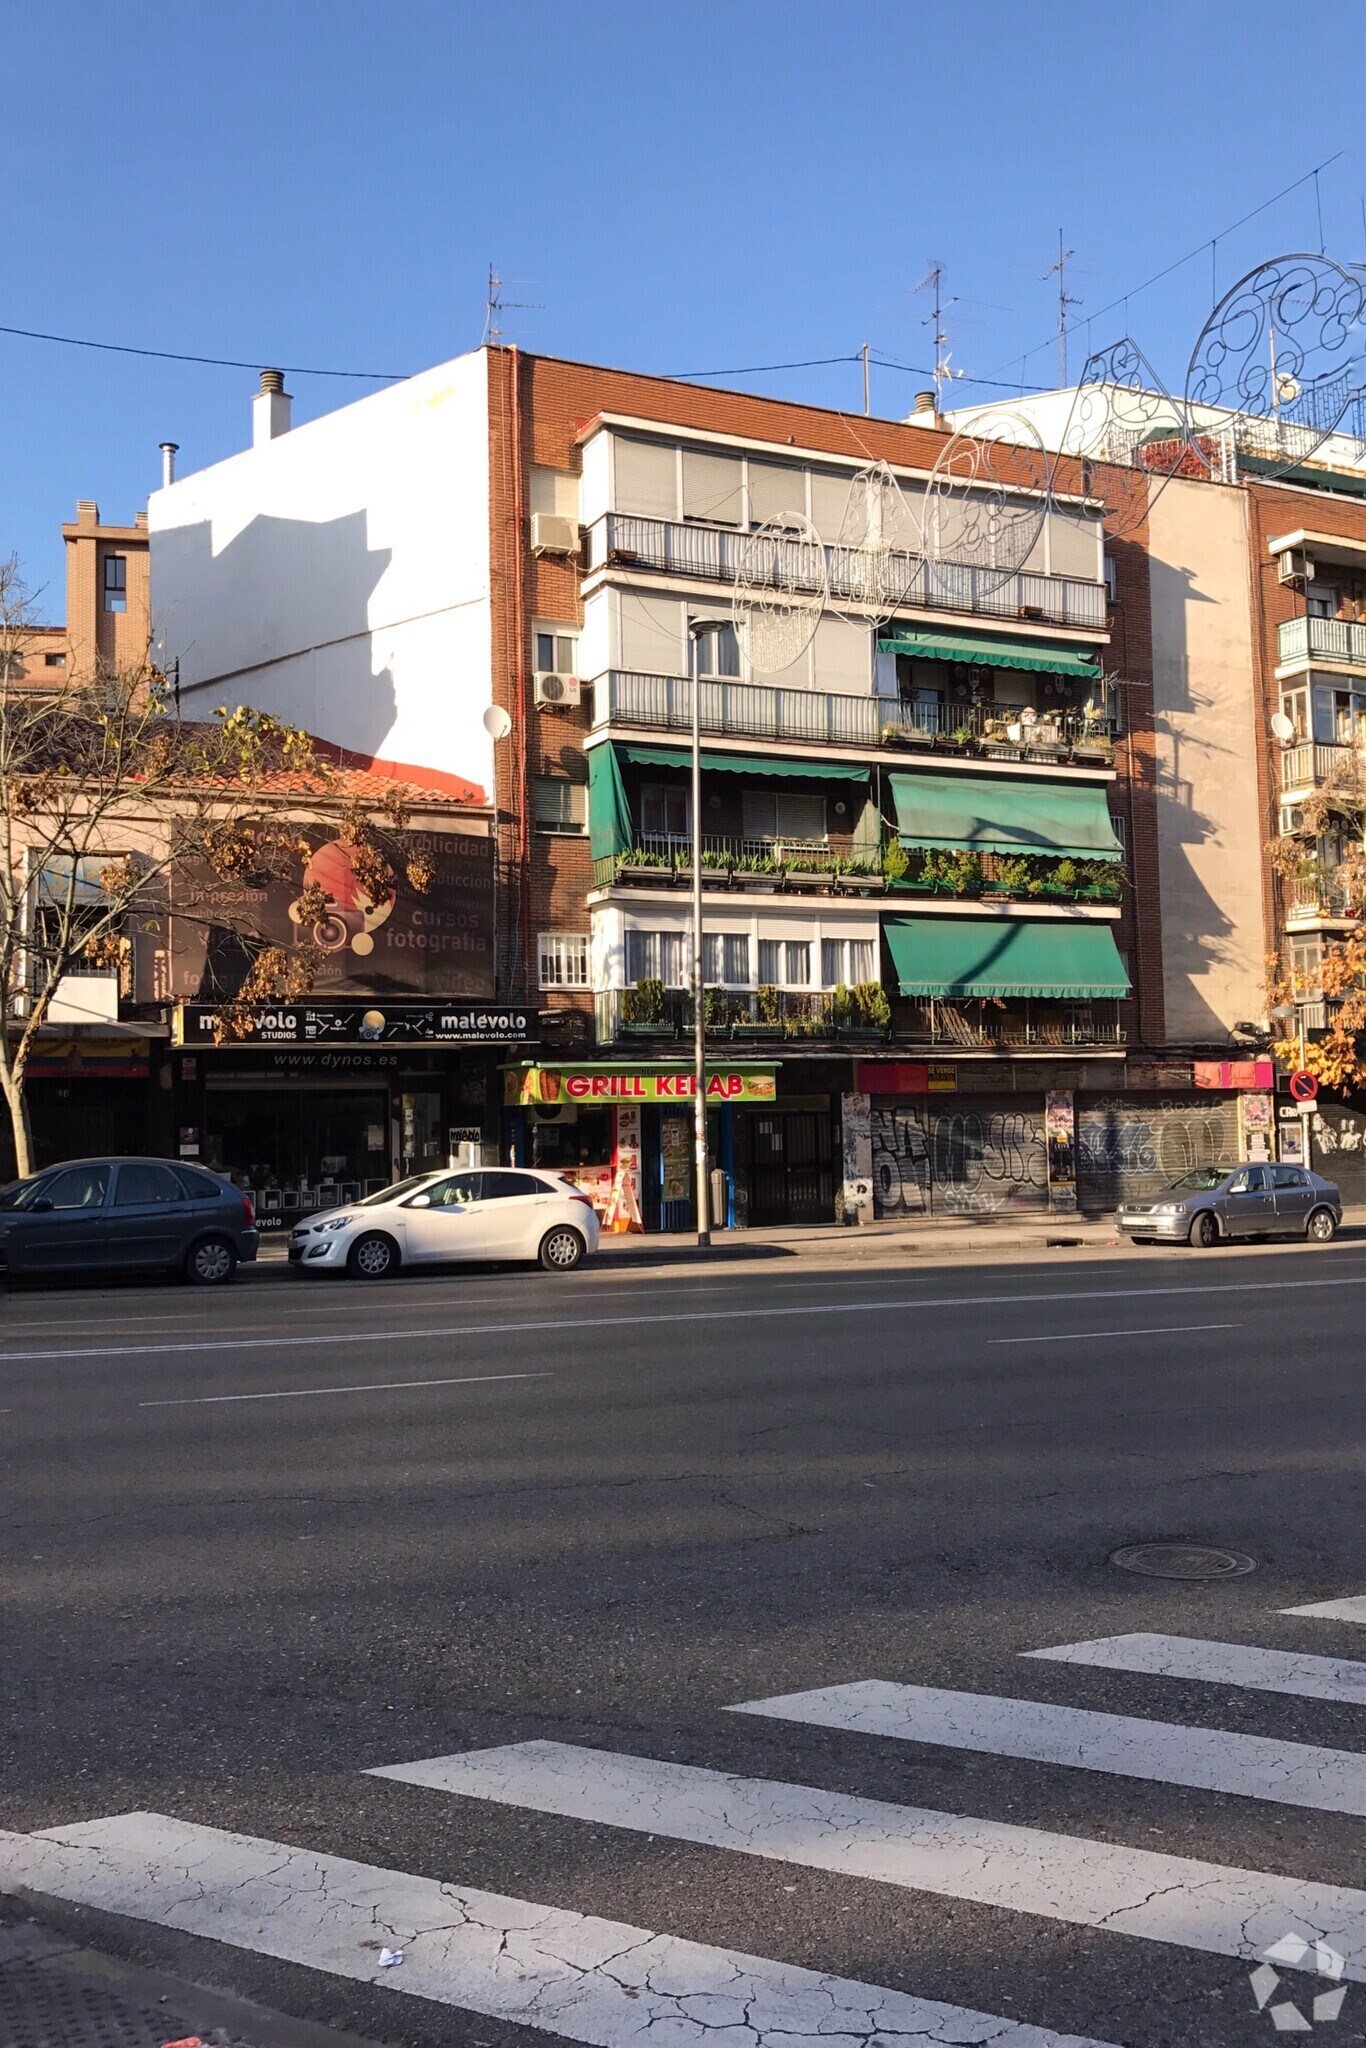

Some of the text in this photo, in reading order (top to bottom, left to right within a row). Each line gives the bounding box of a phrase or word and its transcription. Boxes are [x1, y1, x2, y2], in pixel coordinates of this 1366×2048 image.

[431, 870, 491, 888] ducción
[412, 910, 479, 929] cursos
[386, 928, 487, 953] fotografía
[199, 1010, 297, 1030] mvolo
[261, 1031, 297, 1040] STUDIOS
[435, 1031, 527, 1040] www.malevolo.com
[274, 1054, 398, 1068] www.dynos.es
[640, 1067, 657, 1076] NEW
[566, 1074, 648, 1097] GRILL
[255, 1216, 282, 1227] évolo
